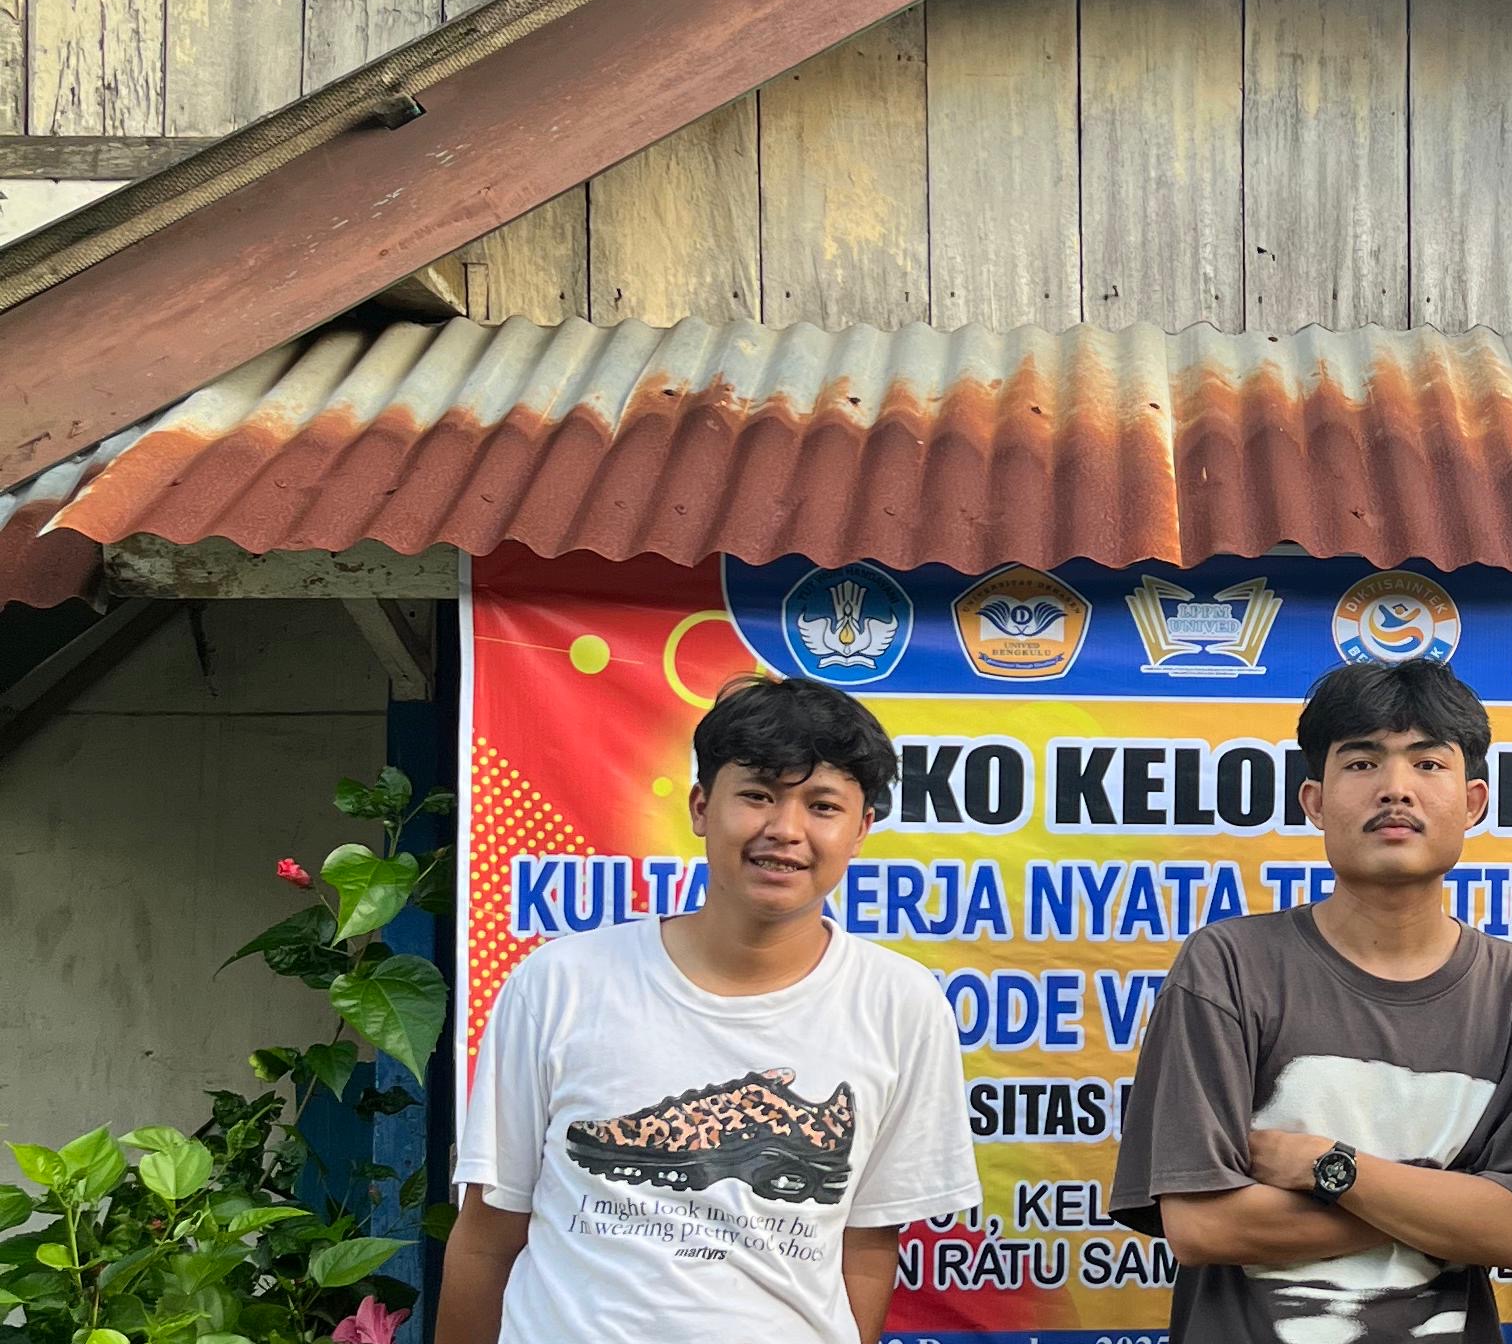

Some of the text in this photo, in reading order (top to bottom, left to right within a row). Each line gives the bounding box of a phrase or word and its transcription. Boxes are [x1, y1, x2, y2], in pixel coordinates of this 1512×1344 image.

[1345, 578, 1449, 614] DIKTISAINTEK
[1169, 619, 1241, 634] UNIVED
[1178, 605, 1231, 619] LPPM
[991, 649, 1052, 657] BENGKULU
[1031, 865, 1246, 937] NYATA
[969, 1083, 1107, 1136] SITAS
[592, 1197, 647, 1221] might
[653, 1199, 700, 1219] look
[706, 1206, 785, 1234] innocent
[595, 1219, 675, 1243] wearing
[680, 1223, 741, 1246] pretty
[674, 1246, 728, 1261] martyrs
[938, 1242, 1066, 1286] RATU
